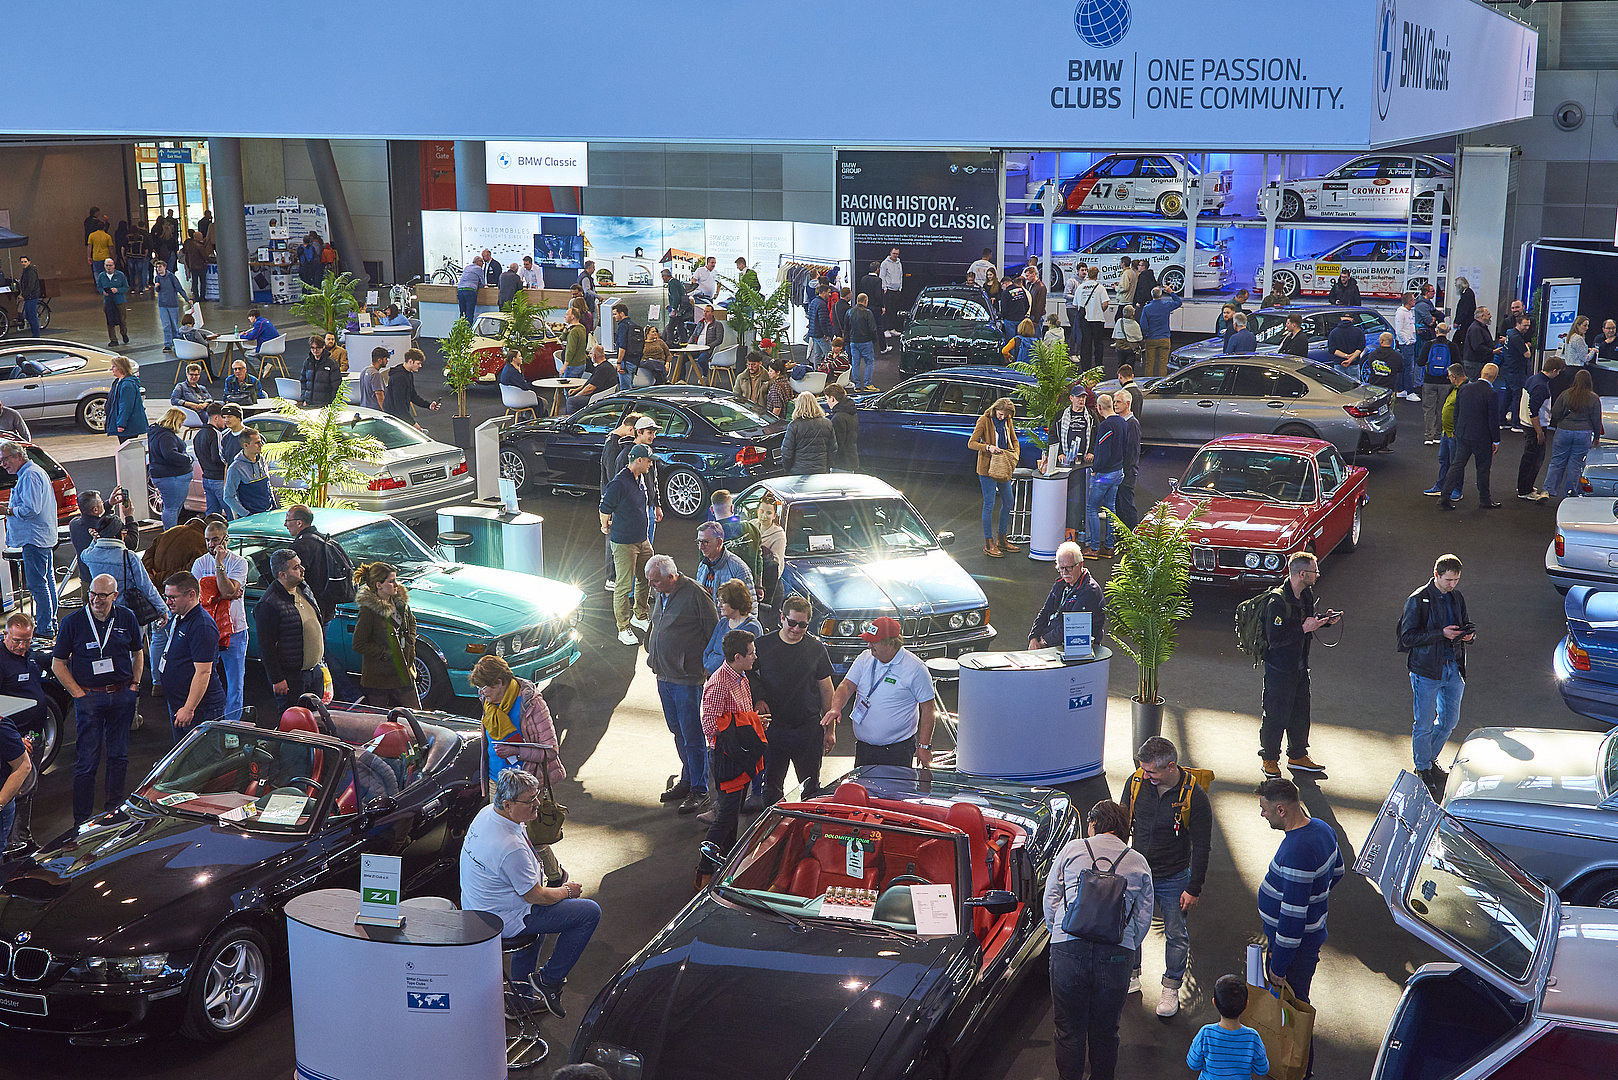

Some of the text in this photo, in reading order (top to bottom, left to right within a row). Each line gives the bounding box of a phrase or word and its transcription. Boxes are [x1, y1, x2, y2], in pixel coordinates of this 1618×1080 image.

[1400, 20, 1451, 91] BMW Classic
[1067, 59, 1123, 82] BMW
[1147, 58, 1307, 81] ONE PASSION.
[1050, 86, 1122, 109] CLUBS
[1146, 86, 1345, 110] ONE COMMUNITY.
[518, 156, 577, 167] BMW Classic
[1090, 183, 1113, 199] 47
[1332, 192, 1337, 202] 1
[841, 194, 960, 211] RACING HISTORY.
[841, 212, 995, 230] BMW GROUP CLASSIC.
